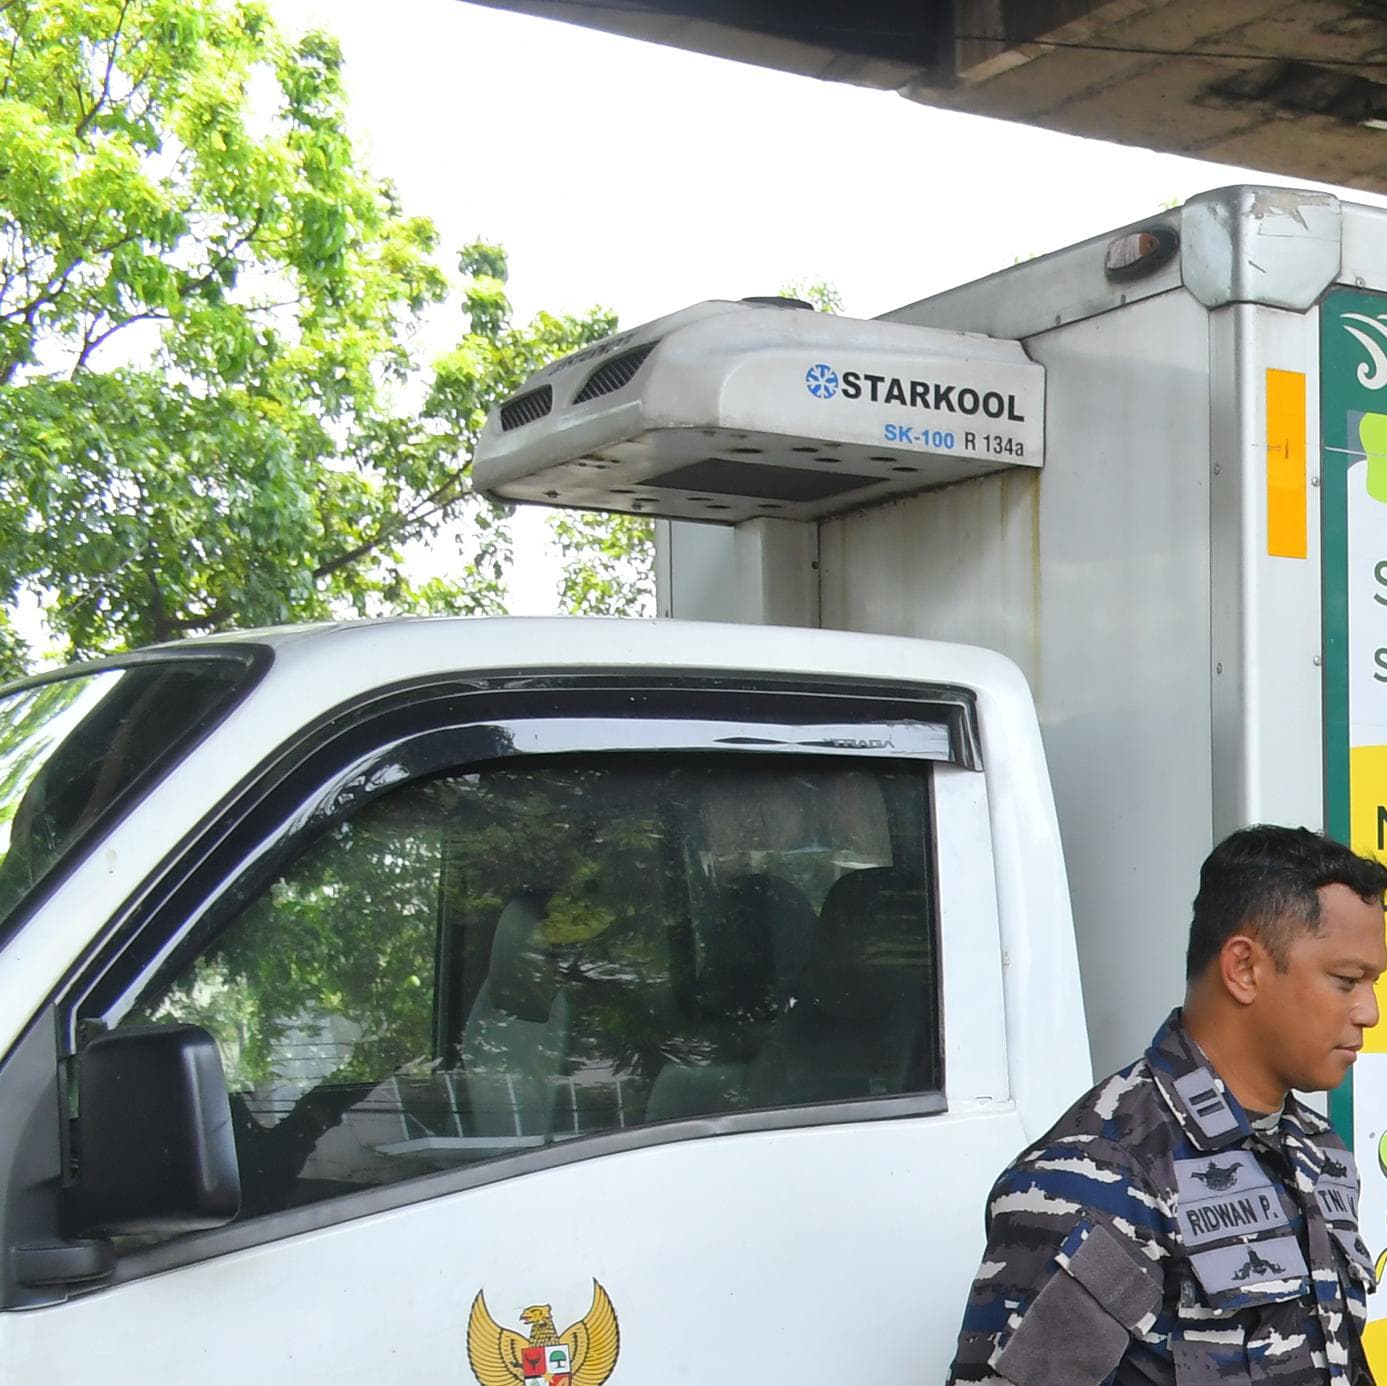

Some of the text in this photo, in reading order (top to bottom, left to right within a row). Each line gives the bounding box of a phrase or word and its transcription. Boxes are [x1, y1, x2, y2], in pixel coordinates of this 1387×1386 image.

[841, 370, 1026, 423] STARKOOL
[884, 423, 1025, 458] SK-100 R 134a
[1186, 1194, 1280, 1238] RIDWAN P.
